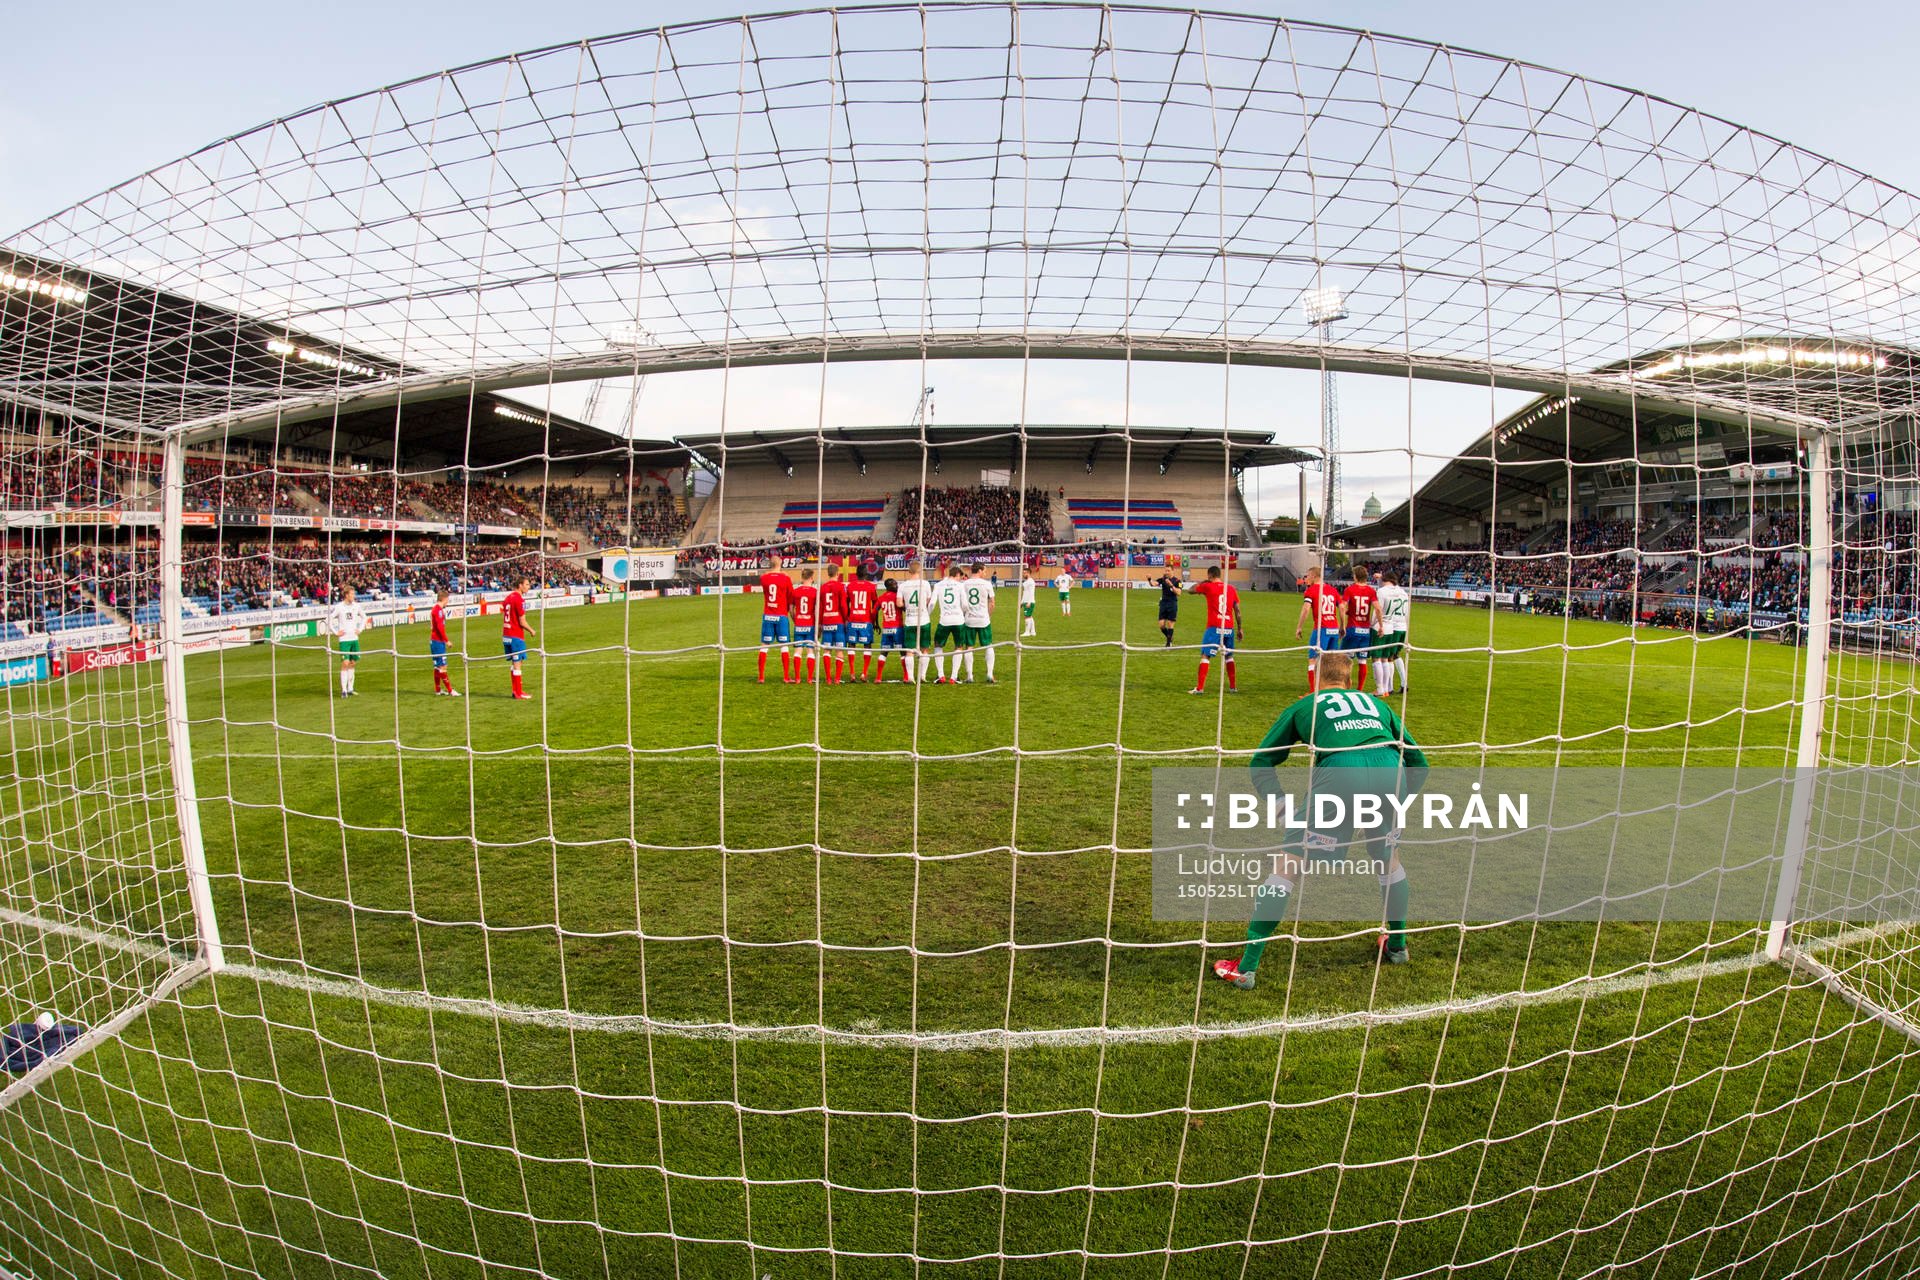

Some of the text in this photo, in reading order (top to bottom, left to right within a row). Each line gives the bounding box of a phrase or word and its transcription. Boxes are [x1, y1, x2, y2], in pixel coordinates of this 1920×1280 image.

[289, 517, 311, 526] BENSIN
[340, 519, 359, 528] DIESEL
[633, 559, 664, 569] Resurs
[633, 569, 656, 578] Bank
[768, 583, 777, 603] 9
[825, 592, 833, 611] 5
[852, 590, 867, 609] 14
[909, 589, 919, 607] 4
[943, 587, 955, 605] 5
[968, 587, 980, 606] 8
[504, 603, 512, 622] 3
[800, 596, 809, 614] 6
[881, 600, 897, 618] 20
[1321, 594, 1335, 615] 26
[1353, 595, 1370, 616] 15
[281, 623, 308, 637] SOLID
[1753, 618, 1771, 628] ALLTID
[87, 651, 132, 669] Scandic
[1316, 692, 1380, 719] 30
[1333, 719, 1384, 732] HANSSON
